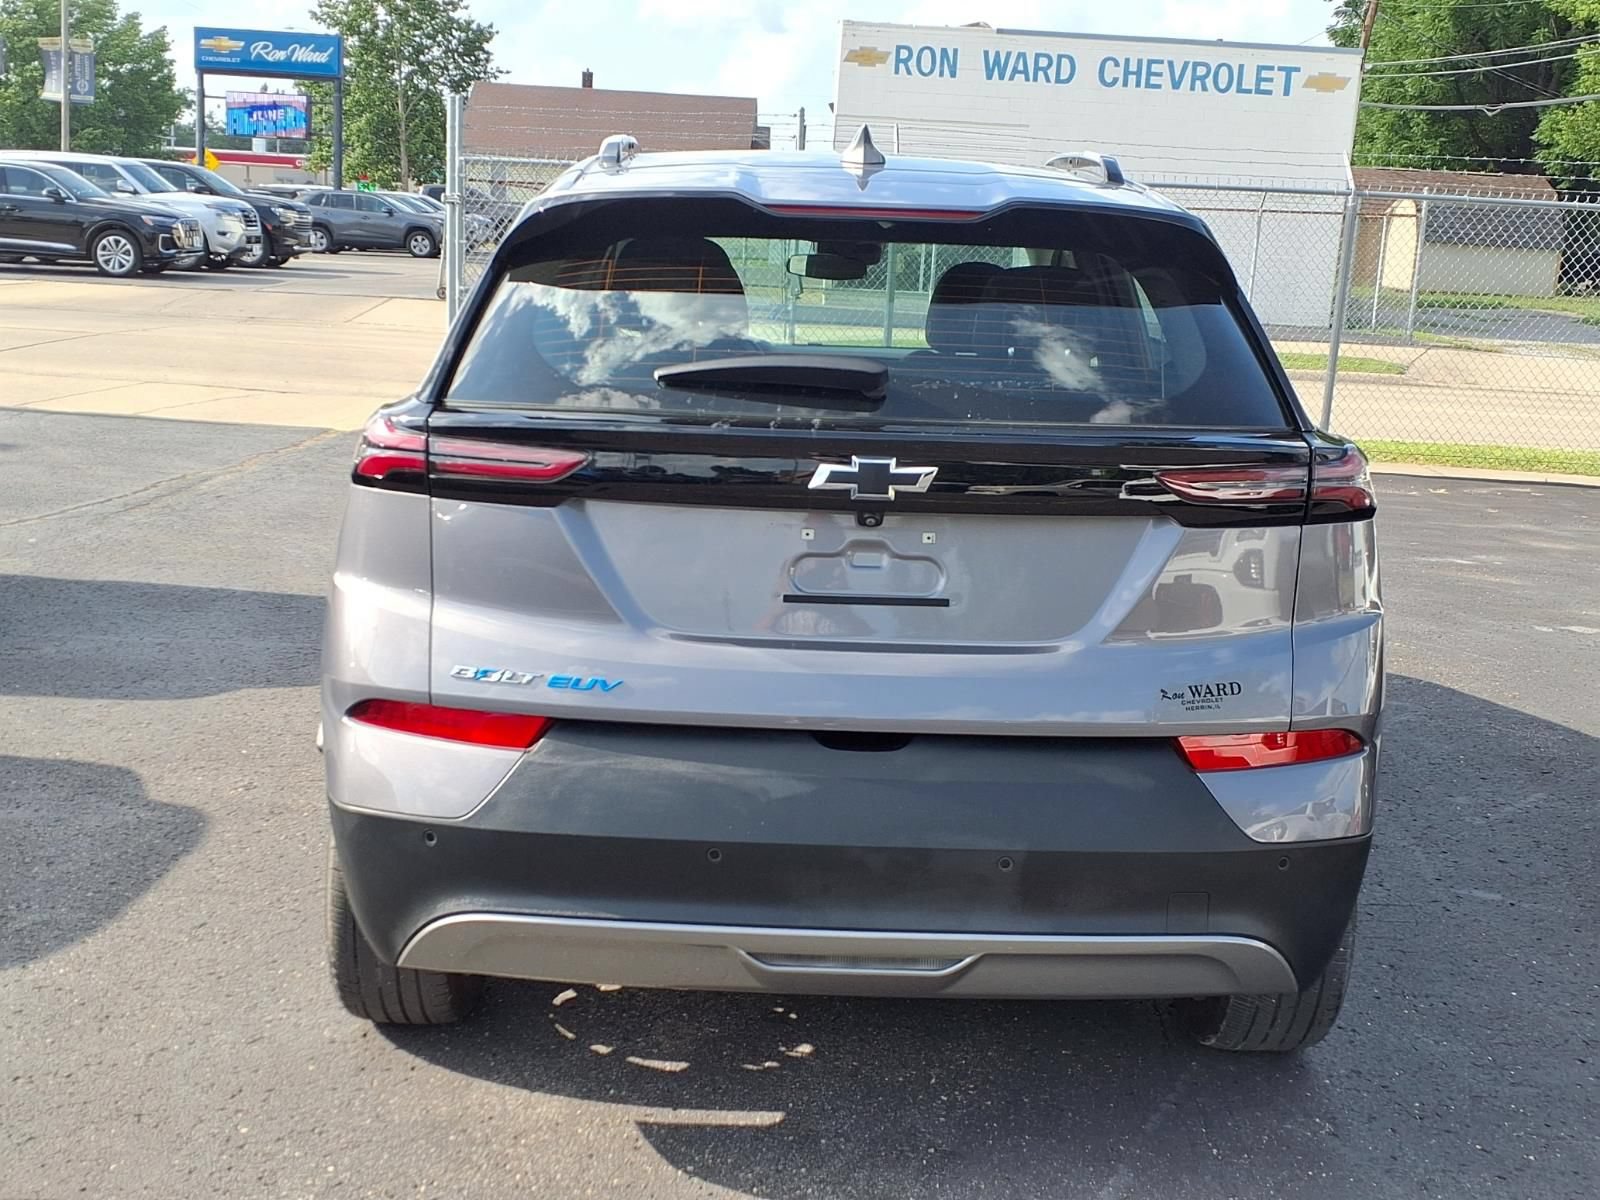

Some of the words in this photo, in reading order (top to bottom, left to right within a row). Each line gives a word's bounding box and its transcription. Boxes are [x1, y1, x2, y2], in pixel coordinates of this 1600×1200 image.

[249, 41, 287, 62] Ron
[288, 43, 335, 64] Ward
[893, 44, 959, 79] RON
[982, 49, 1077, 85] WARD
[1097, 55, 1301, 97] CHEVROLET
[450, 665, 544, 685] BOLT
[547, 673, 624, 692] EUV
[1160, 688, 1185, 701] Ron
[1188, 681, 1242, 699] WARD
[1181, 697, 1224, 706] CHEVROLET
